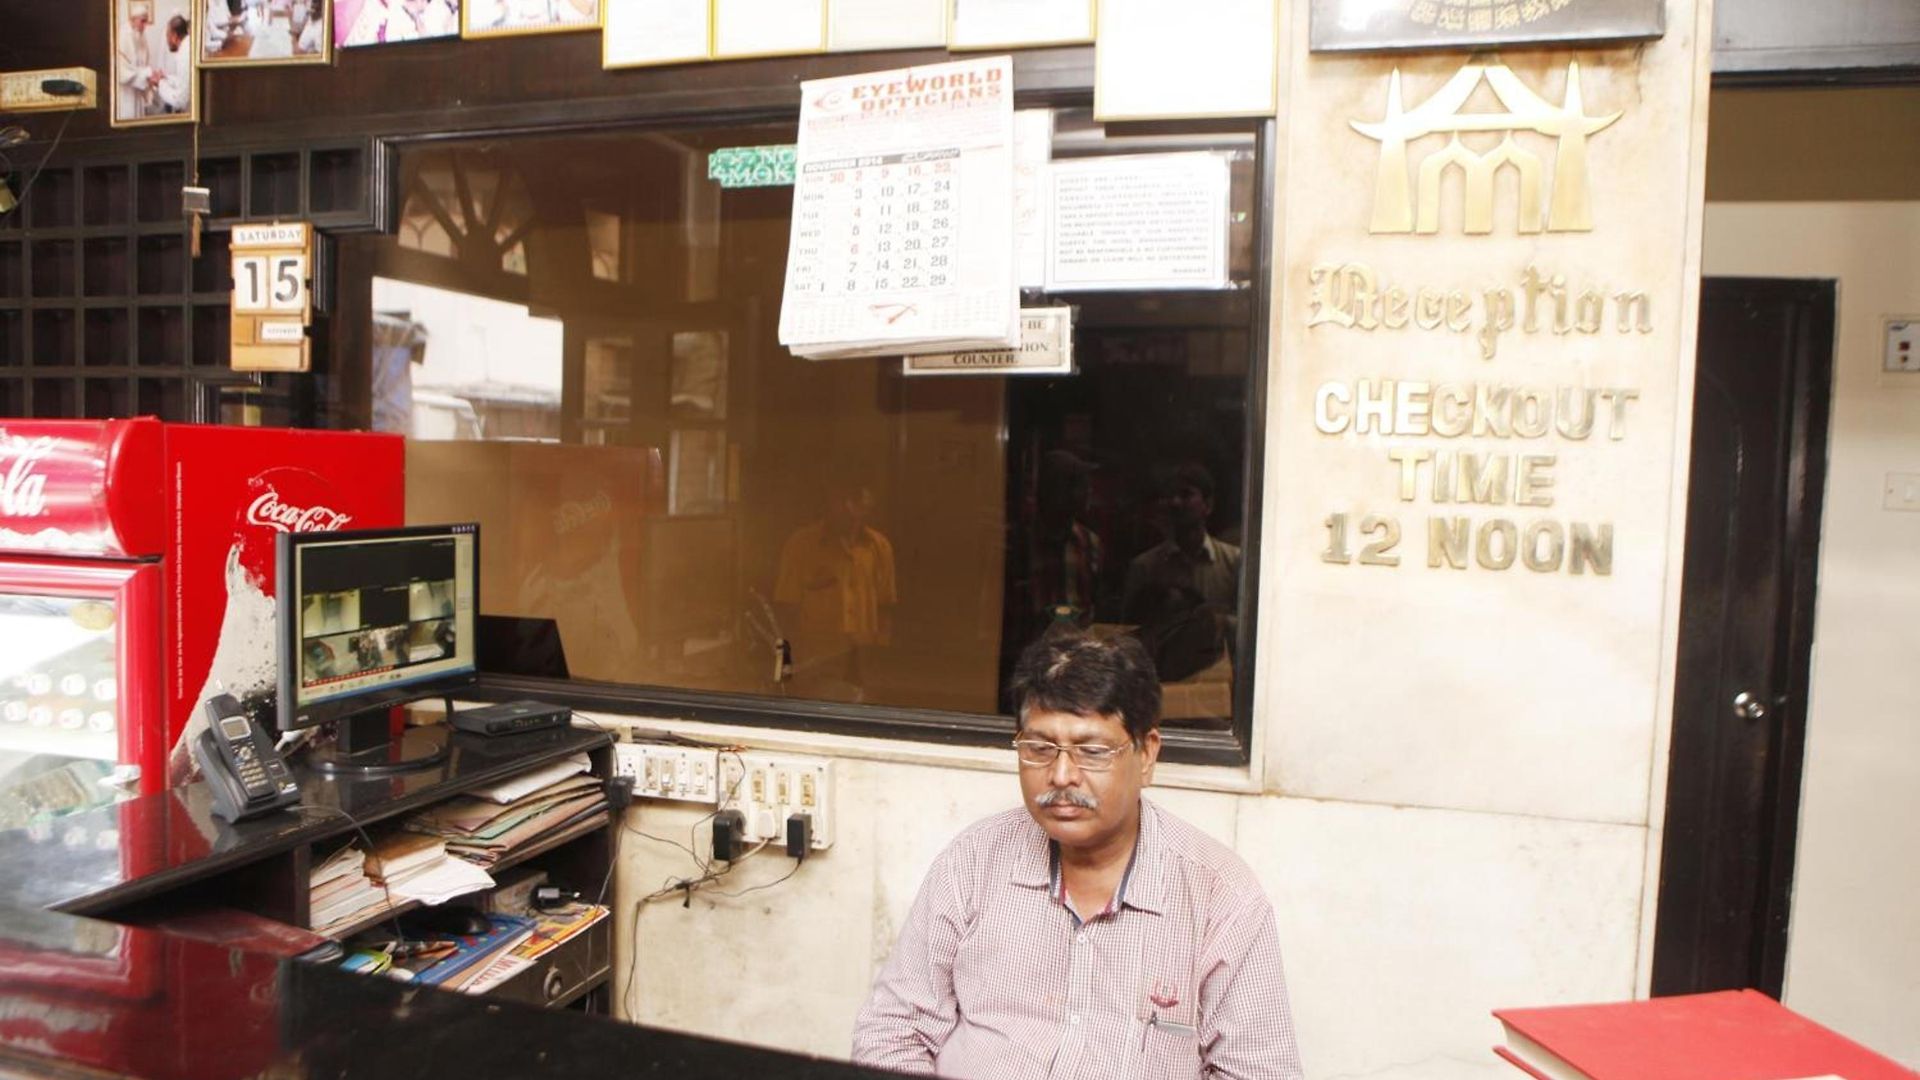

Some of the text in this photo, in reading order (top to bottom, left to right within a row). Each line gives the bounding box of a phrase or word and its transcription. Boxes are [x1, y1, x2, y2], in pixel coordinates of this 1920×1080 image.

[852, 68, 1002, 100] EYEWORLD
[861, 84, 1001, 112] OPTICIANS
[712, 164, 798, 187] SMOK
[855, 188, 862, 200] 3
[880, 186, 894, 198] 10
[907, 184, 921, 196] 17
[934, 181, 950, 193] 24
[854, 207, 861, 219] 4
[880, 204, 892, 216] 11
[907, 202, 920, 214] 18
[933, 199, 949, 211] 25
[240, 229, 301, 242] SATURDAY
[879, 223, 893, 235] 12
[906, 221, 919, 232] 19
[932, 218, 949, 230] 26
[878, 241, 891, 253] 13
[904, 239, 921, 251] 20
[932, 236, 949, 248] 27
[849, 262, 857, 273] 7
[876, 259, 890, 271] 14
[904, 257, 917, 269] 21
[931, 255, 948, 267] 28
[244, 259, 299, 303] 15
[847, 279, 856, 291] 8
[875, 277, 888, 289] 15
[902, 276, 919, 288] 22
[930, 274, 946, 286] 29
[1308, 263, 1654, 360] Reception
[1028, 319, 1046, 330] BE
[1314, 378, 1639, 441] CHECKOUT
[1388, 450, 1557, 508] TIME
[246, 491, 352, 532] Coca-Col
[1321, 512, 1614, 577] 12 NOON
